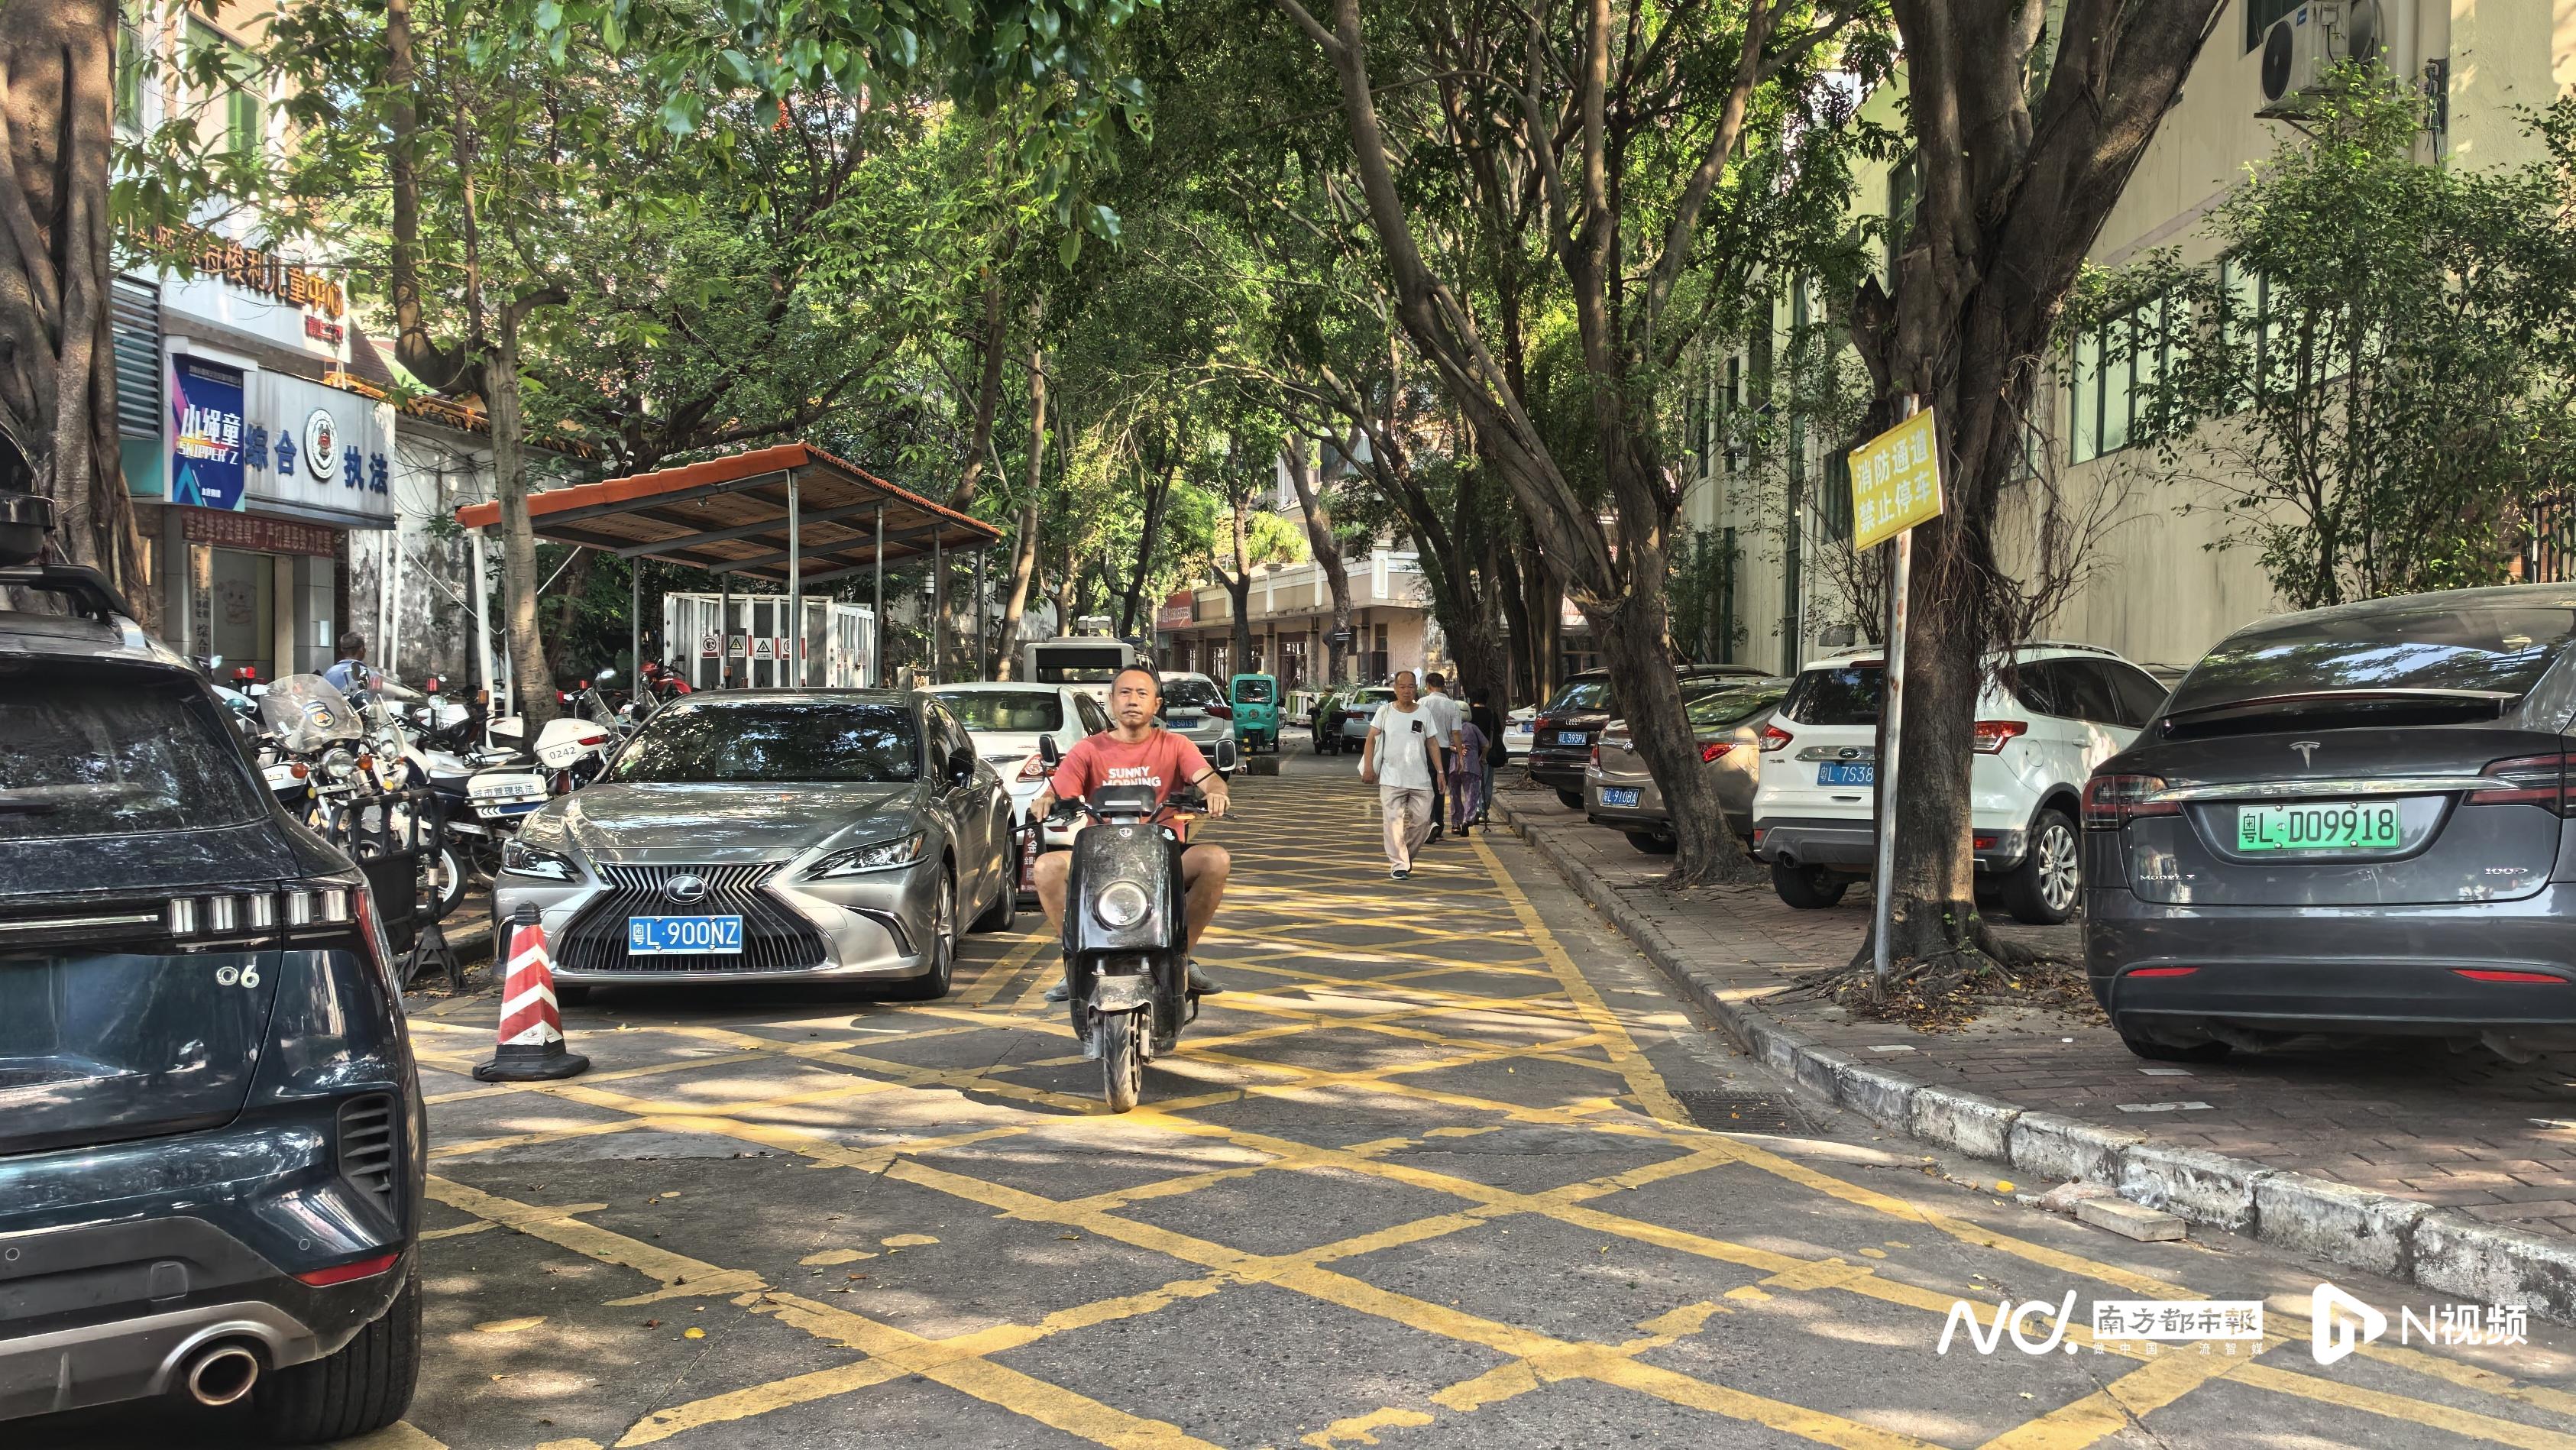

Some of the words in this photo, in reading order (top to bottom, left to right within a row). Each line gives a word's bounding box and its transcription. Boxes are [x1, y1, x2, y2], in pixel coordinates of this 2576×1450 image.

[180, 404, 241, 448] 小绳童
[244, 422, 297, 477] 综合
[343, 445, 389, 495] 执法
[1856, 428, 1929, 495] 消防通道
[1859, 470, 1932, 534] 禁止停车
[549, 746, 577, 760] 0242
[1108, 765, 1150, 778] SUNNY
[1820, 765, 1874, 782] 粤L·7S38
[216, 964, 260, 989] 06
